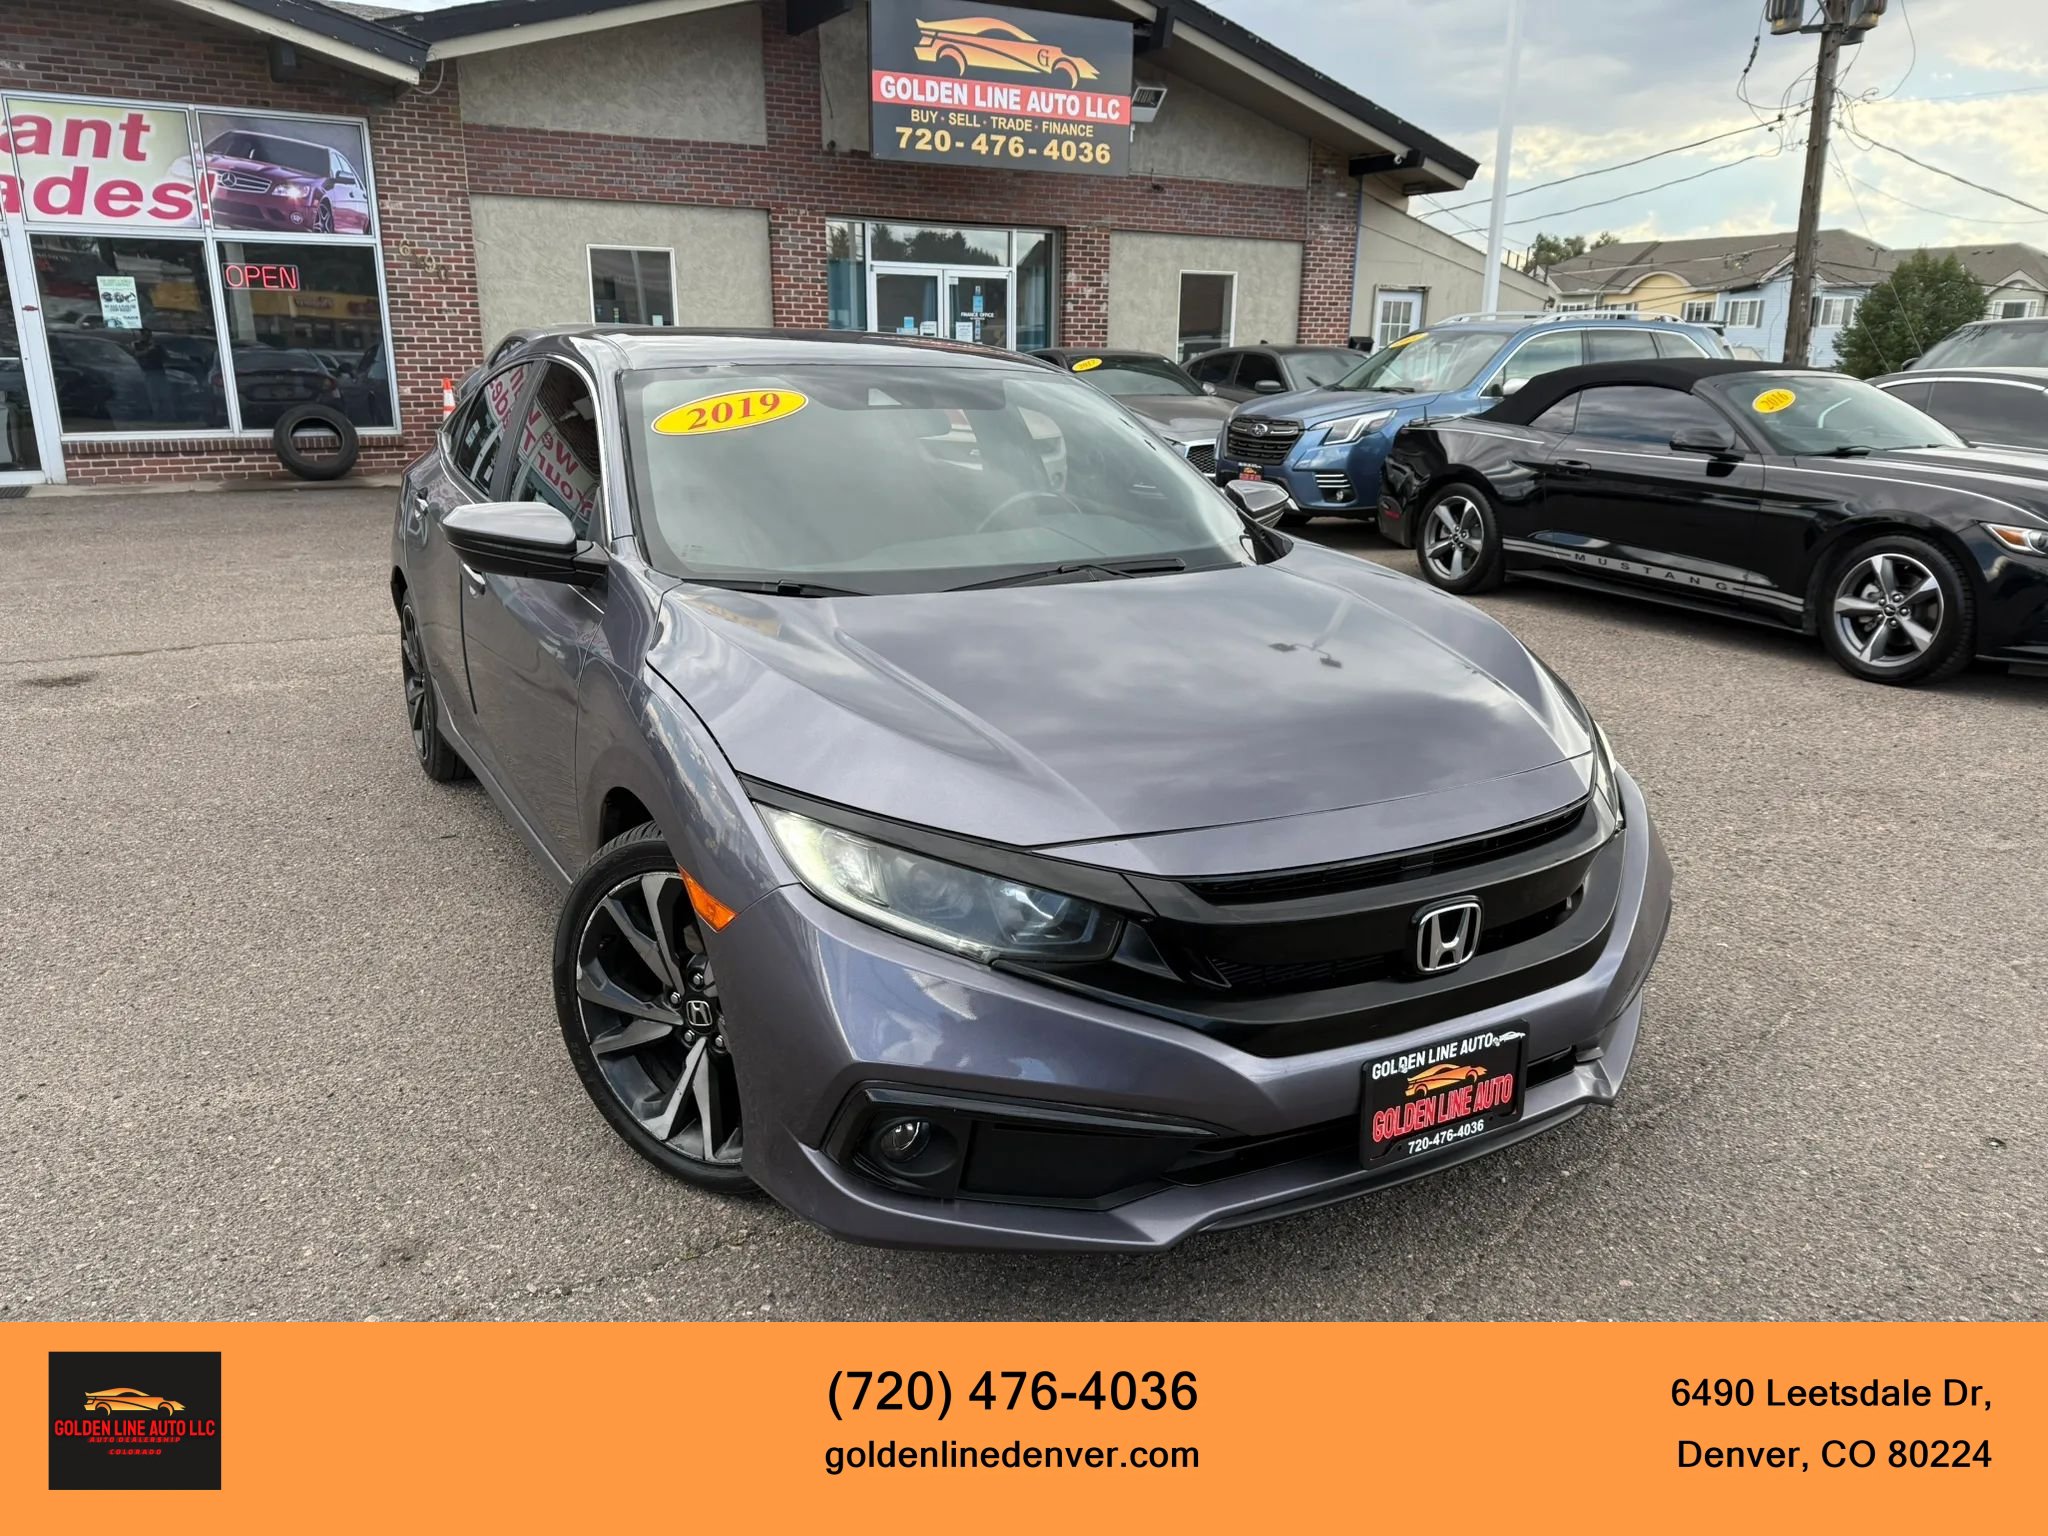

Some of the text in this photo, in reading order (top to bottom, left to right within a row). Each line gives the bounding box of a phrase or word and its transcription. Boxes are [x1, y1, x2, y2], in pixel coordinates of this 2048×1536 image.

[880, 75, 1121, 121] GOLDEN LINE AUTO LLC
[910, 109, 1094, 138] BUY SELL TRADE FINANCE
[225, 265, 297, 289] OPEN
[687, 392, 781, 430] 2019
[1574, 553, 1728, 591] MUSTANG
[1371, 1032, 1493, 1080] GOLDEN LINE AUTO
[1372, 1073, 1513, 1143] GOLDEN LINE AUTO
[1408, 1119, 1484, 1154] 720-476-4036
